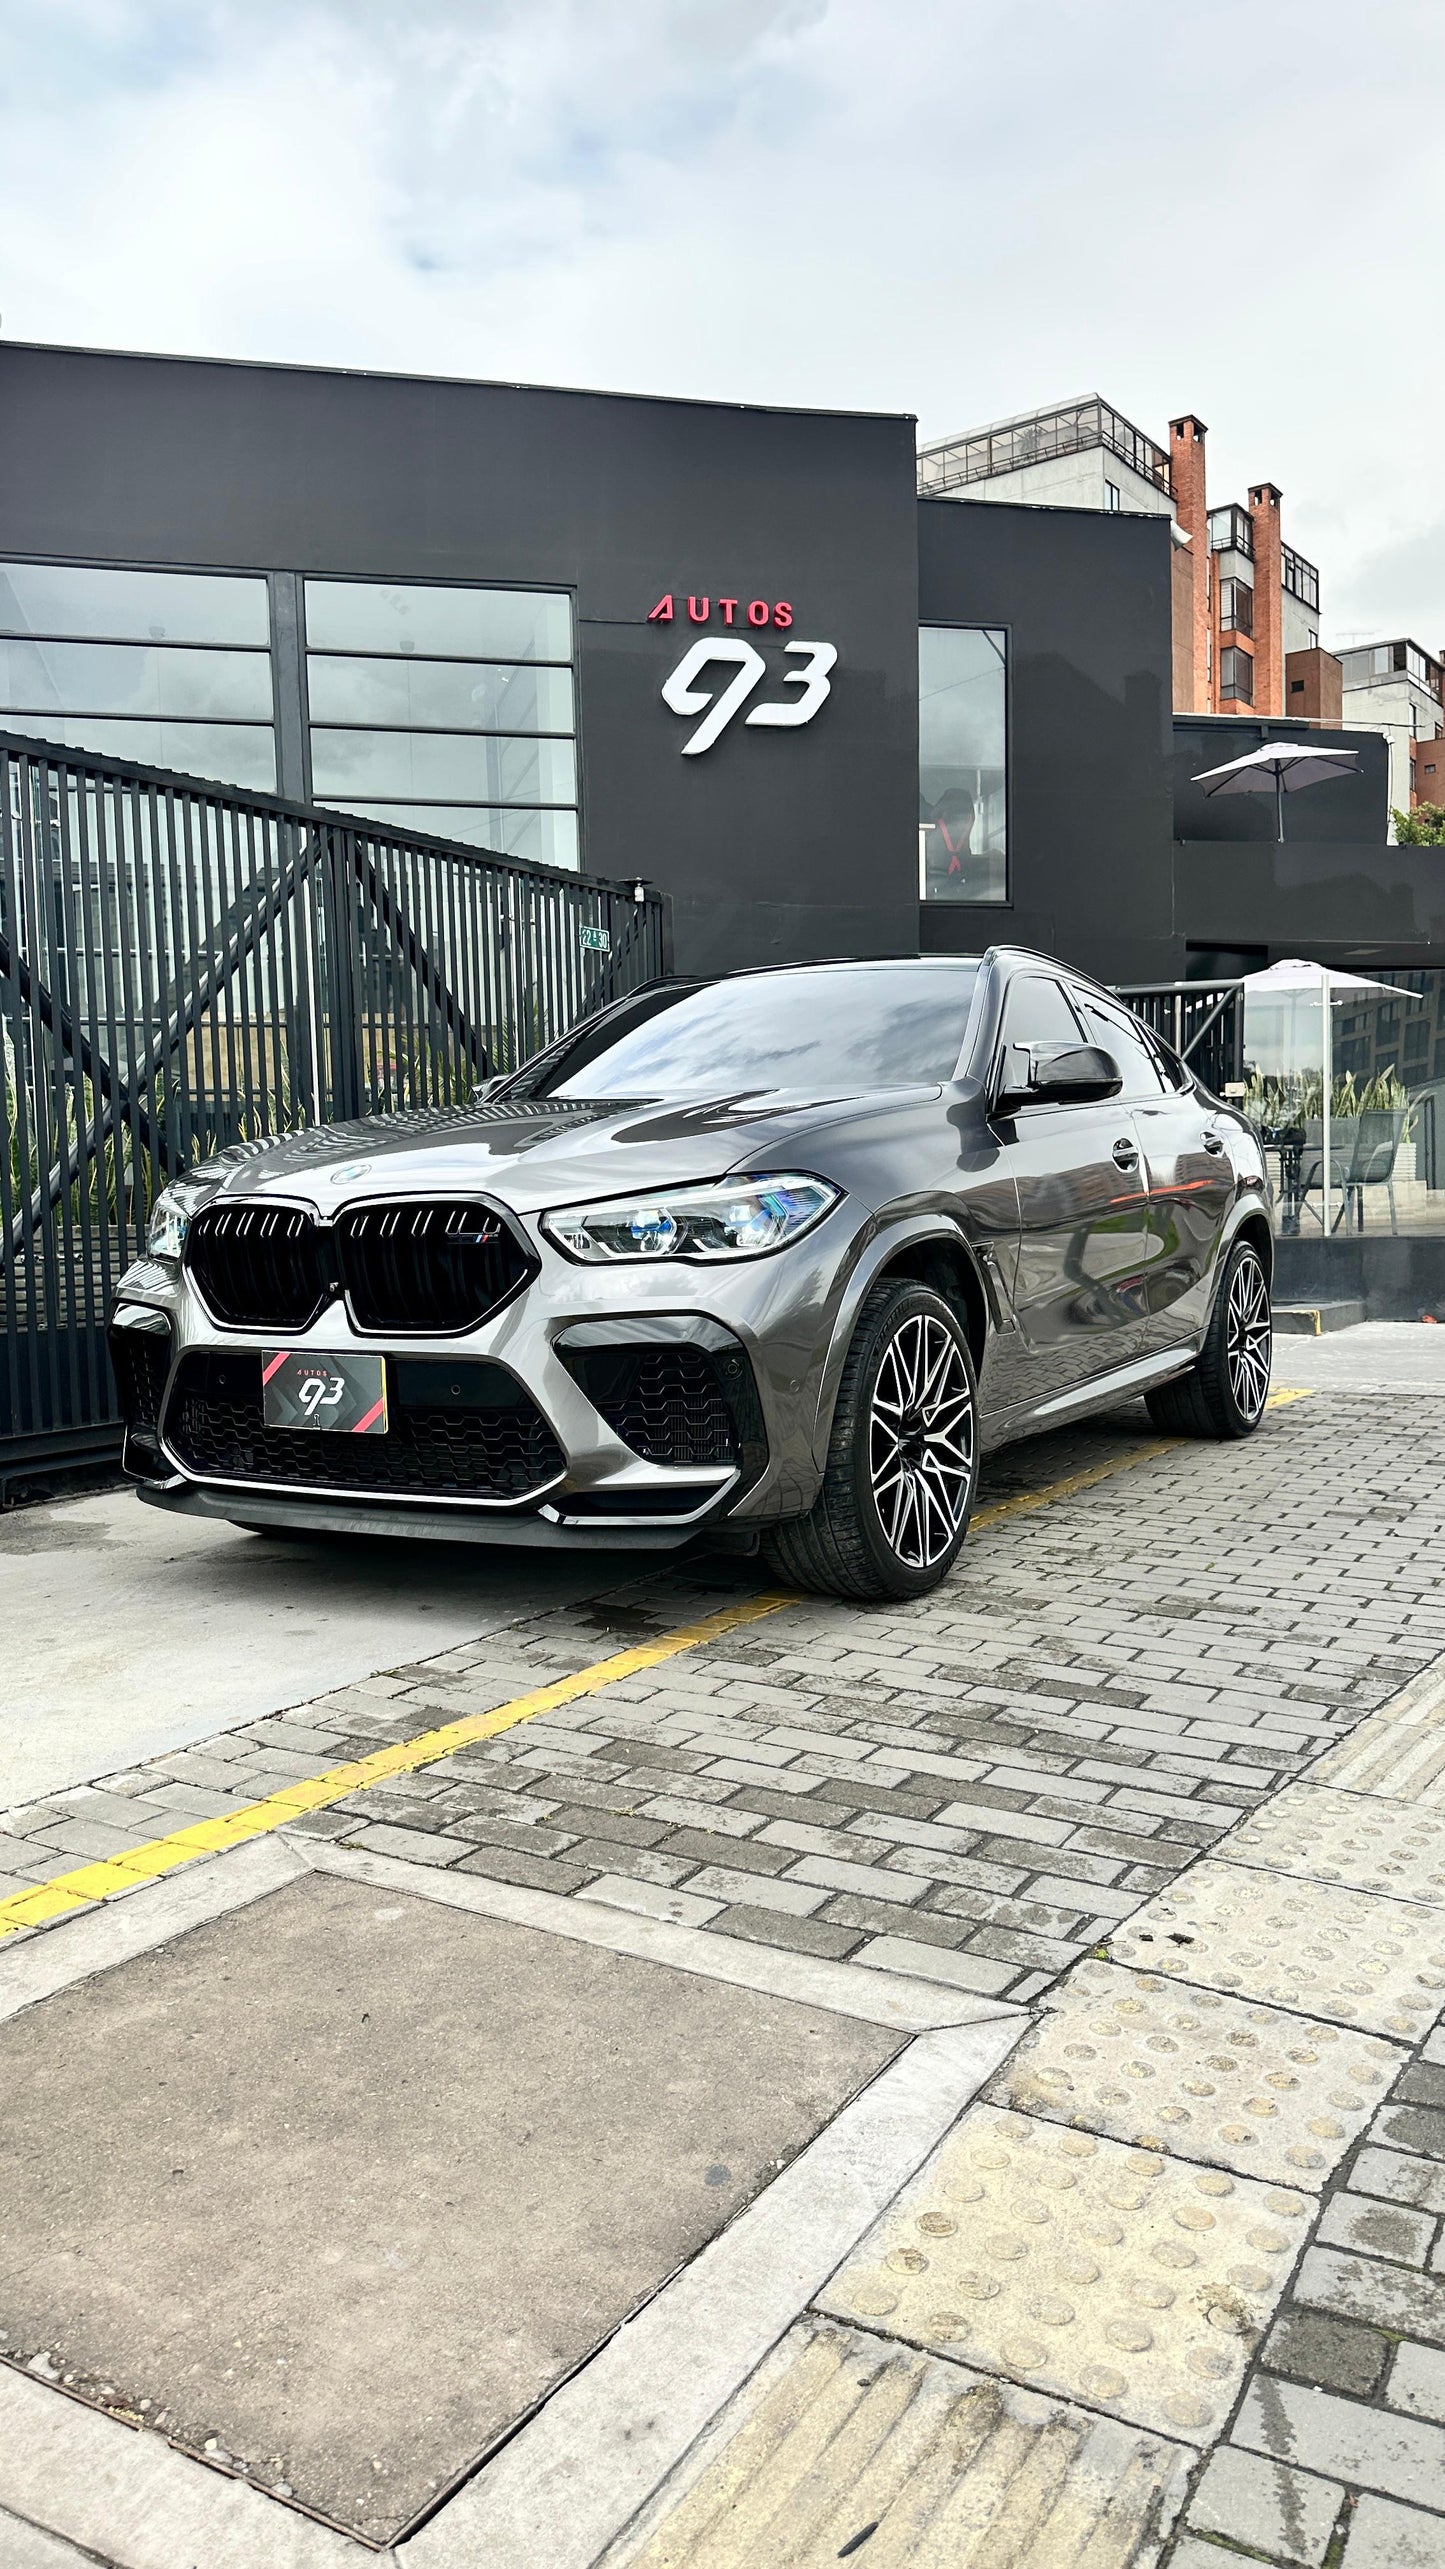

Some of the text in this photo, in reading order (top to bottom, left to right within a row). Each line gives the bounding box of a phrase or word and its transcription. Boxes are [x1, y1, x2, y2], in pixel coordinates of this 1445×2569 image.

[648, 594, 793, 629] AUTOS
[661, 637, 838, 755] 93
[296, 1369, 328, 1377] AUTOS
[298, 1377, 345, 1416] 93
